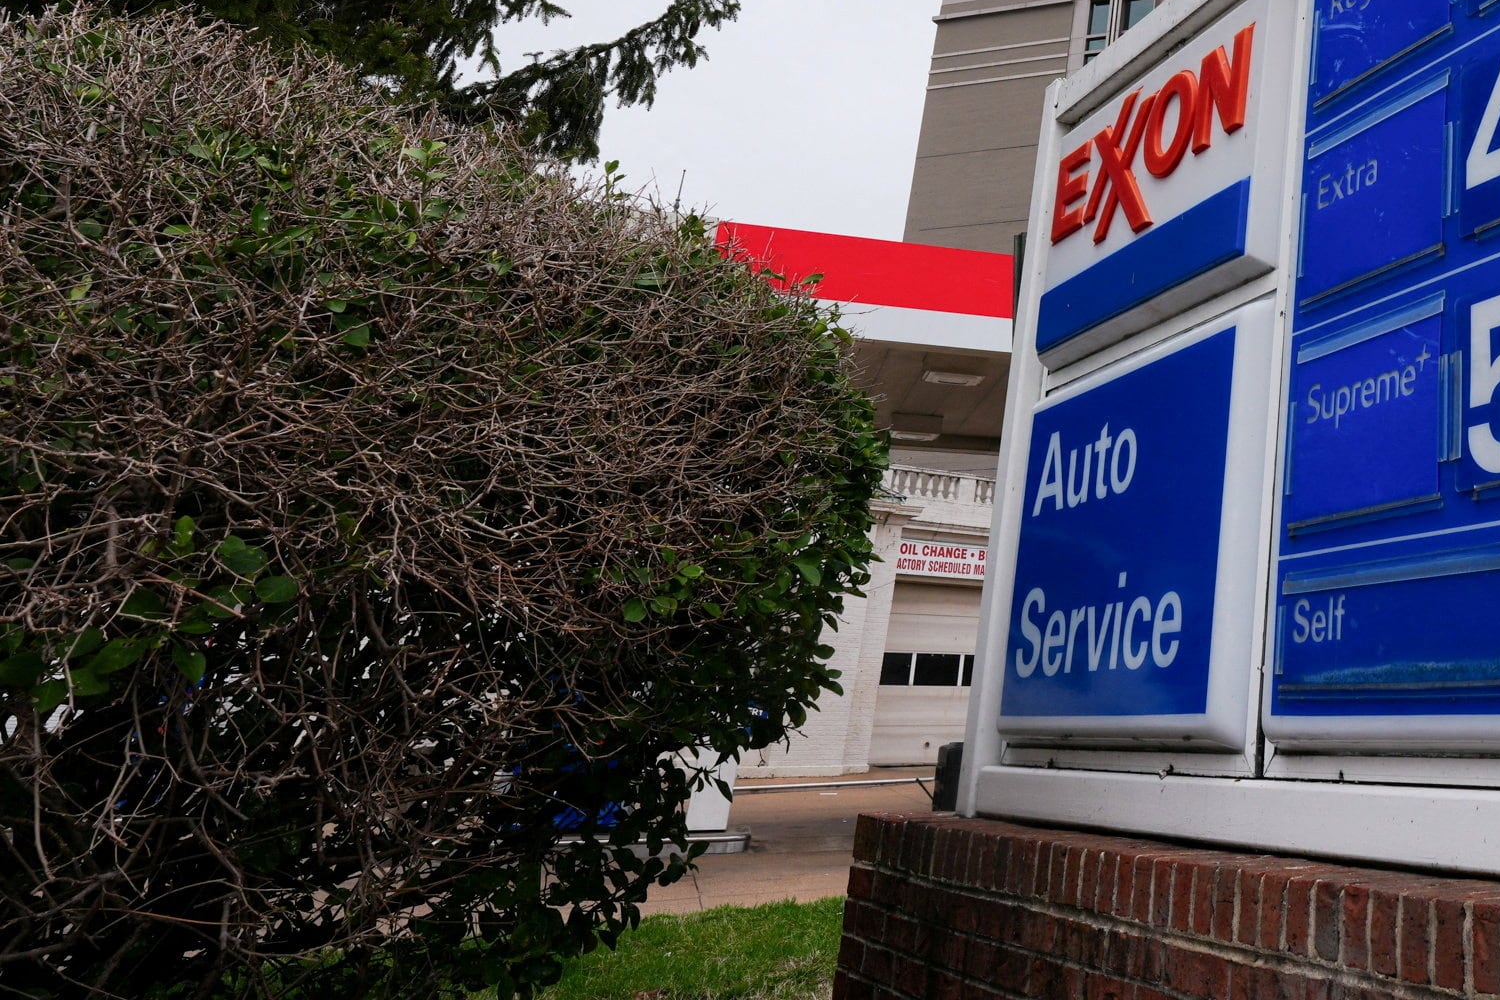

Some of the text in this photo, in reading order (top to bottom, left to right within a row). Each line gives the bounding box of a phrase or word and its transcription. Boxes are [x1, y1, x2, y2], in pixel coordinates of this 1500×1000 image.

[1051, 21, 1257, 246] EXXON
[1316, 158, 1379, 211] Extra
[1032, 422, 1138, 517] Auto
[896, 558, 985, 576] ACTORY SCHEDULED MA
[900, 543, 918, 556] OIL
[922, 545, 968, 559] CHANGE
[1015, 571, 1183, 678] Service
[1292, 595, 1346, 644] Self
